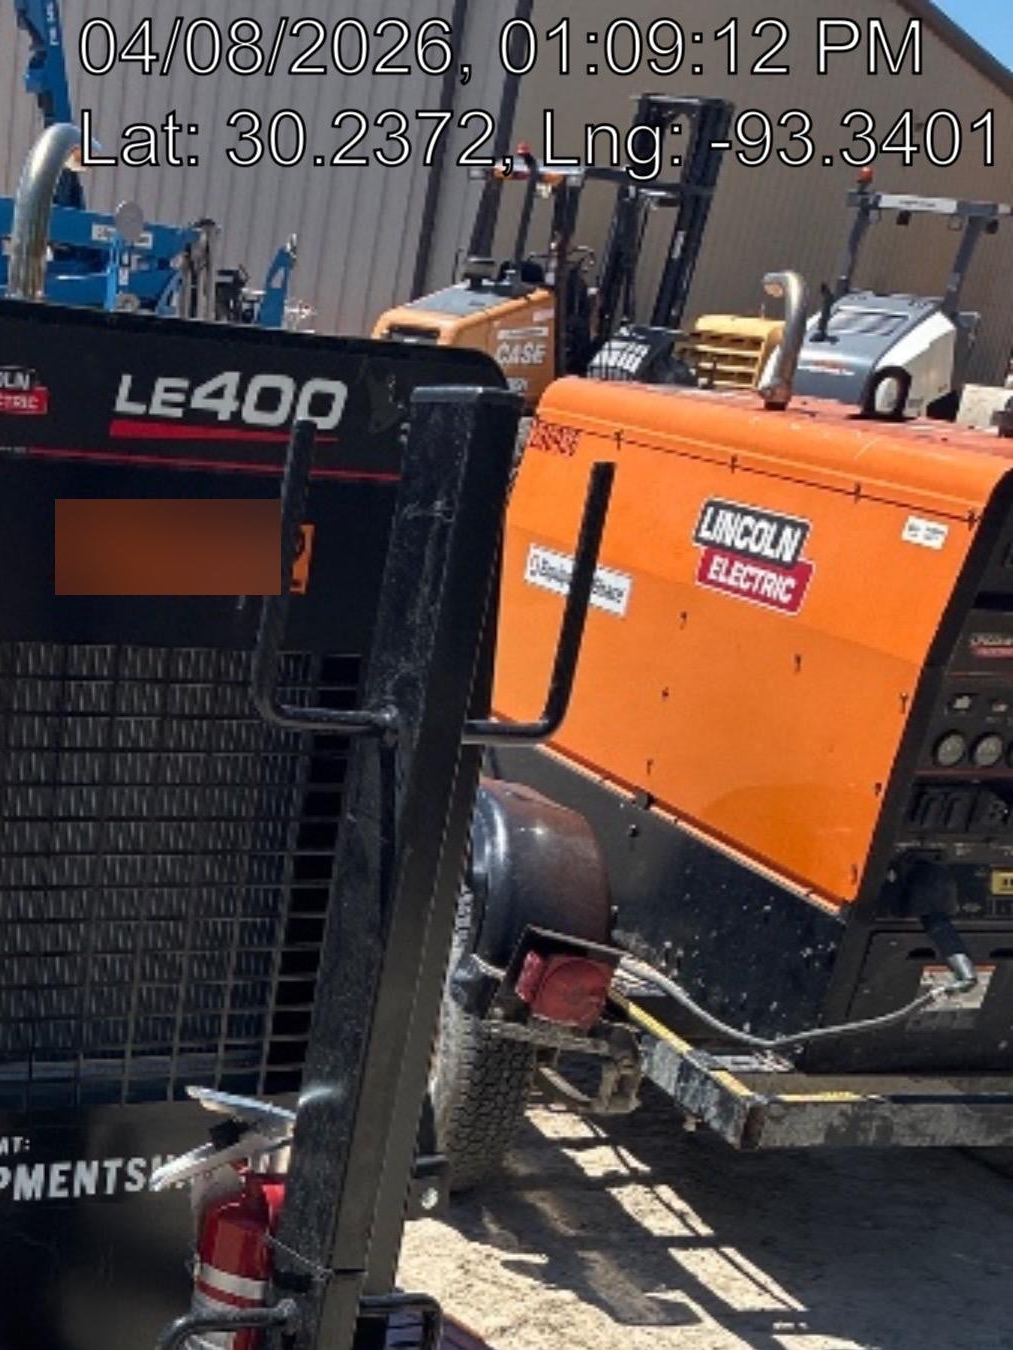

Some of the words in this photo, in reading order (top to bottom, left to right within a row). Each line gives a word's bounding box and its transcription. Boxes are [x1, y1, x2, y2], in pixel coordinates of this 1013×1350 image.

[496, 342, 546, 364] CASE
[114, 371, 348, 431] LE400
[700, 506, 804, 563] LINCOLN
[708, 560, 796, 604] ELECTRIC
